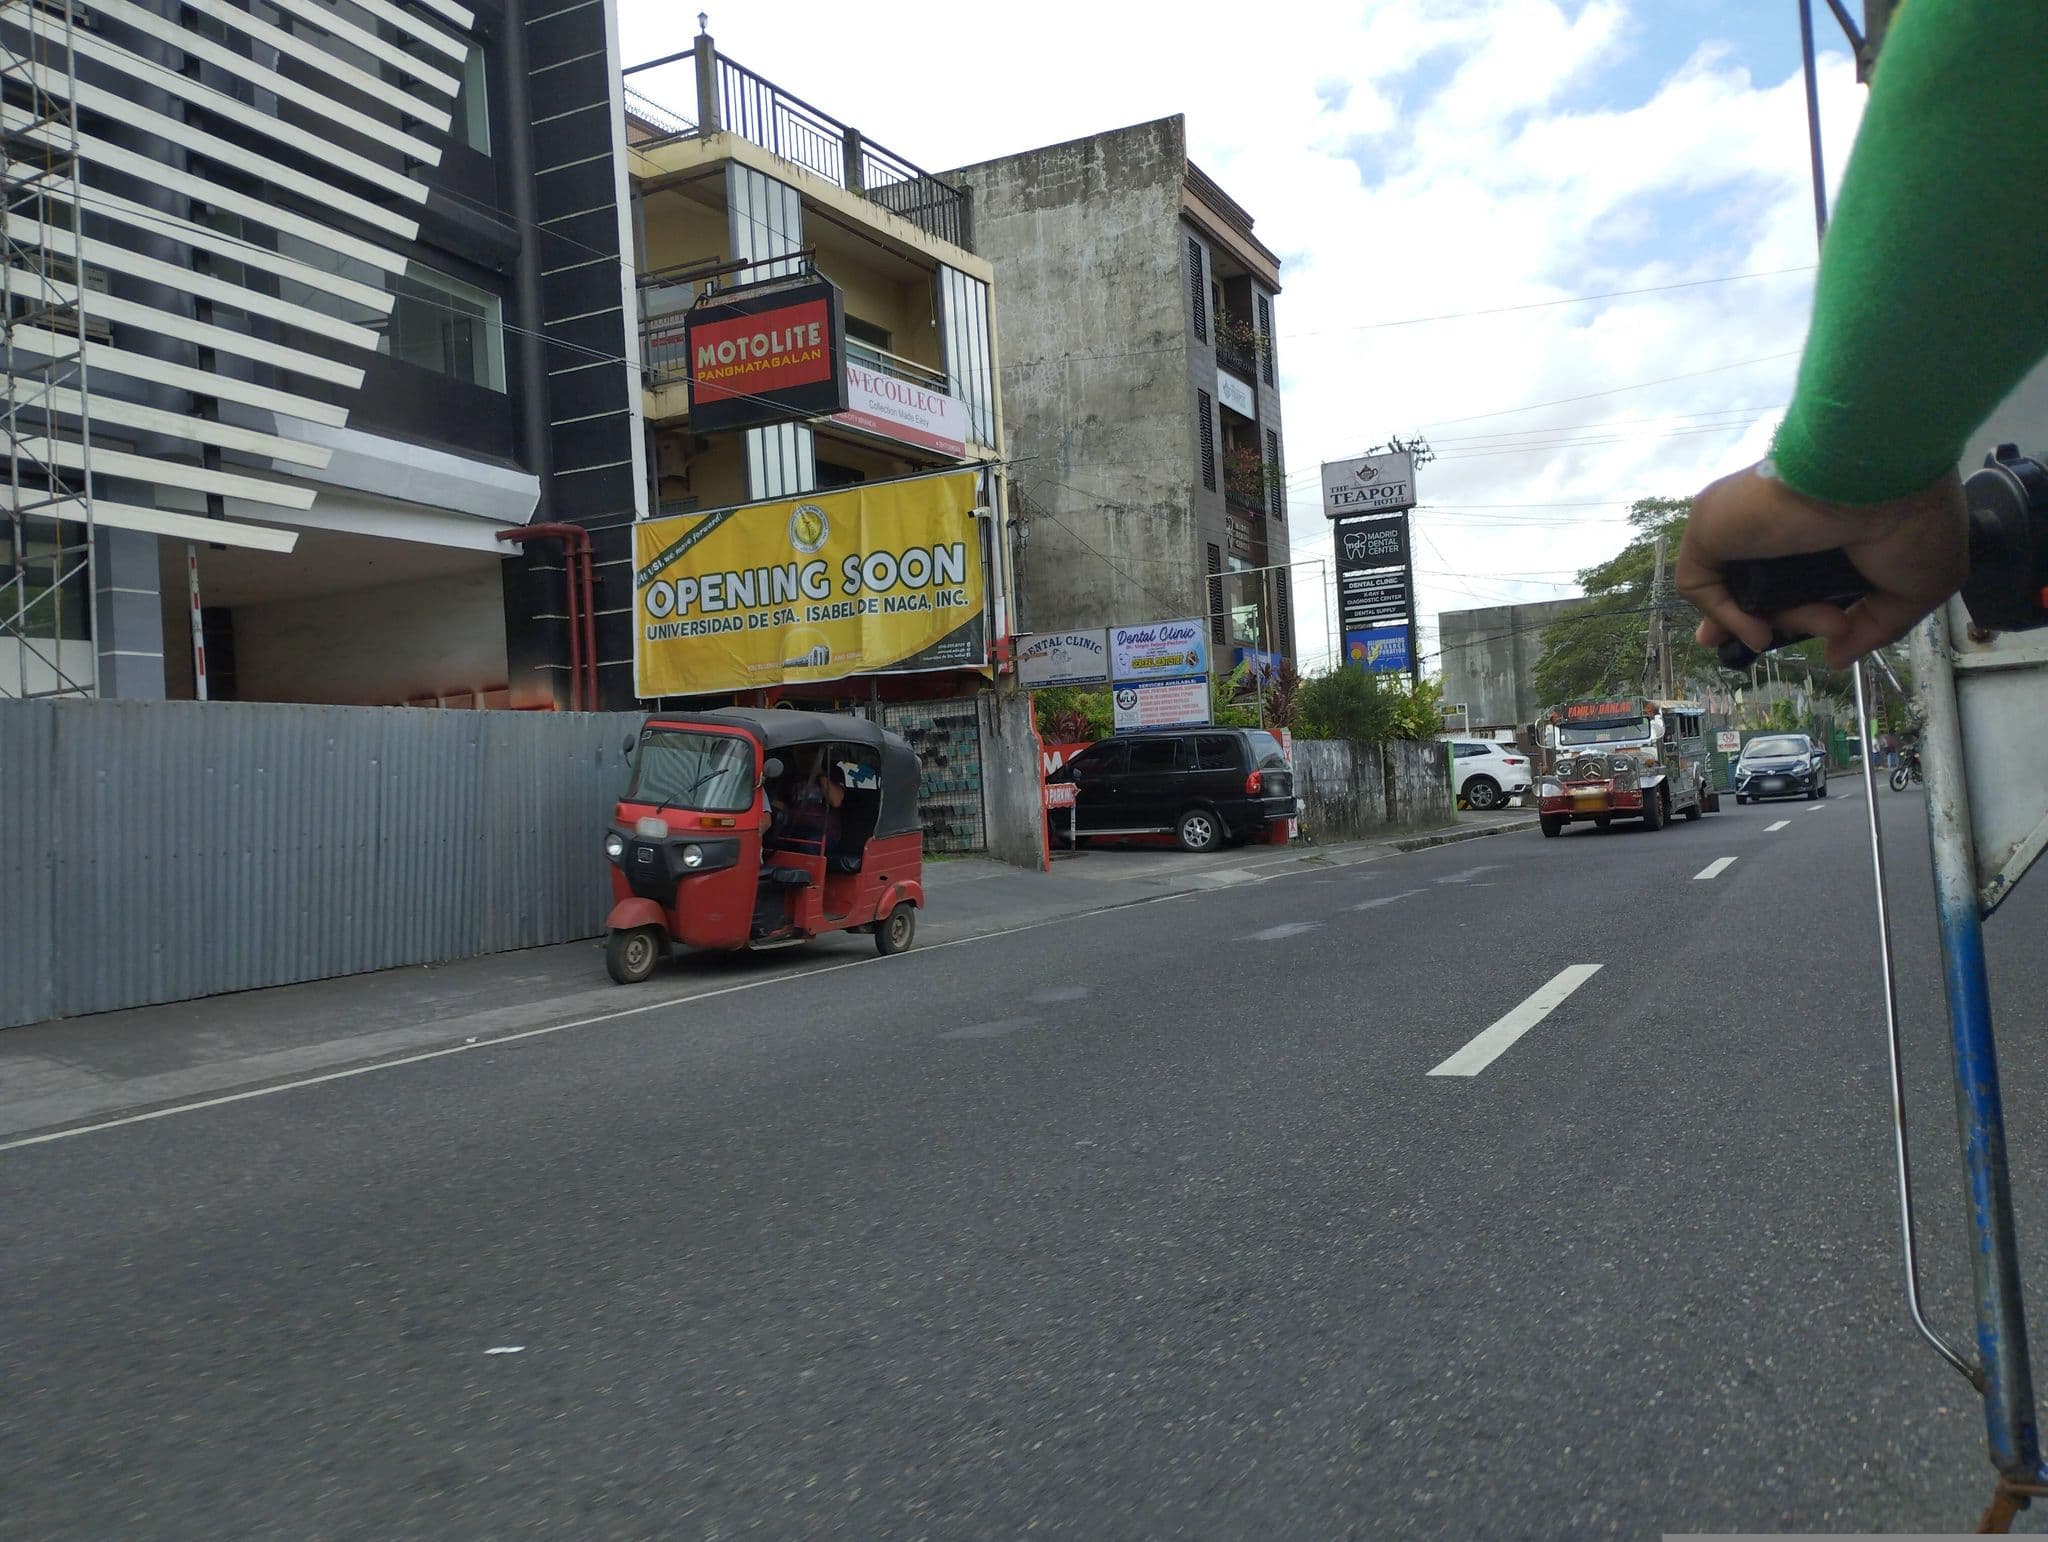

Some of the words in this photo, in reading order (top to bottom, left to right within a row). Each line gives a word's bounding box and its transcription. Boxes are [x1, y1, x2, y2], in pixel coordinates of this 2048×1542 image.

[698, 322, 821, 369] MOTOLITE
[698, 349, 821, 382] PANGMATAGALAN
[847, 366, 946, 417] WECOLLECT
[868, 400, 898, 417] Collection
[899, 410, 916, 421] Made
[916, 414, 929, 428] Easy
[1330, 485, 1349, 494] THE
[1330, 484, 1407, 505] TEAPOT
[1374, 497, 1405, 506] HOTEL
[1368, 530, 1398, 540] MADRID
[1368, 538, 1398, 548] DENTAL
[1368, 545, 1399, 555] CENTER
[645, 561, 831, 619] OPENING
[842, 542, 966, 596] SOON
[1349, 580, 1375, 589] DENTAL
[646, 615, 744, 641] UNIVERSIDAD
[748, 612, 769, 629] DE
[773, 608, 800, 626] STA.
[806, 601, 855, 622] ISABEL
[858, 598, 878, 614] DE
[884, 596, 932, 613] NAGA,
[936, 589, 969, 607] INC.
[1066, 635, 1102, 655] CLINIC
[1117, 629, 1156, 646] Dental
[1160, 626, 1196, 642] Clinic
